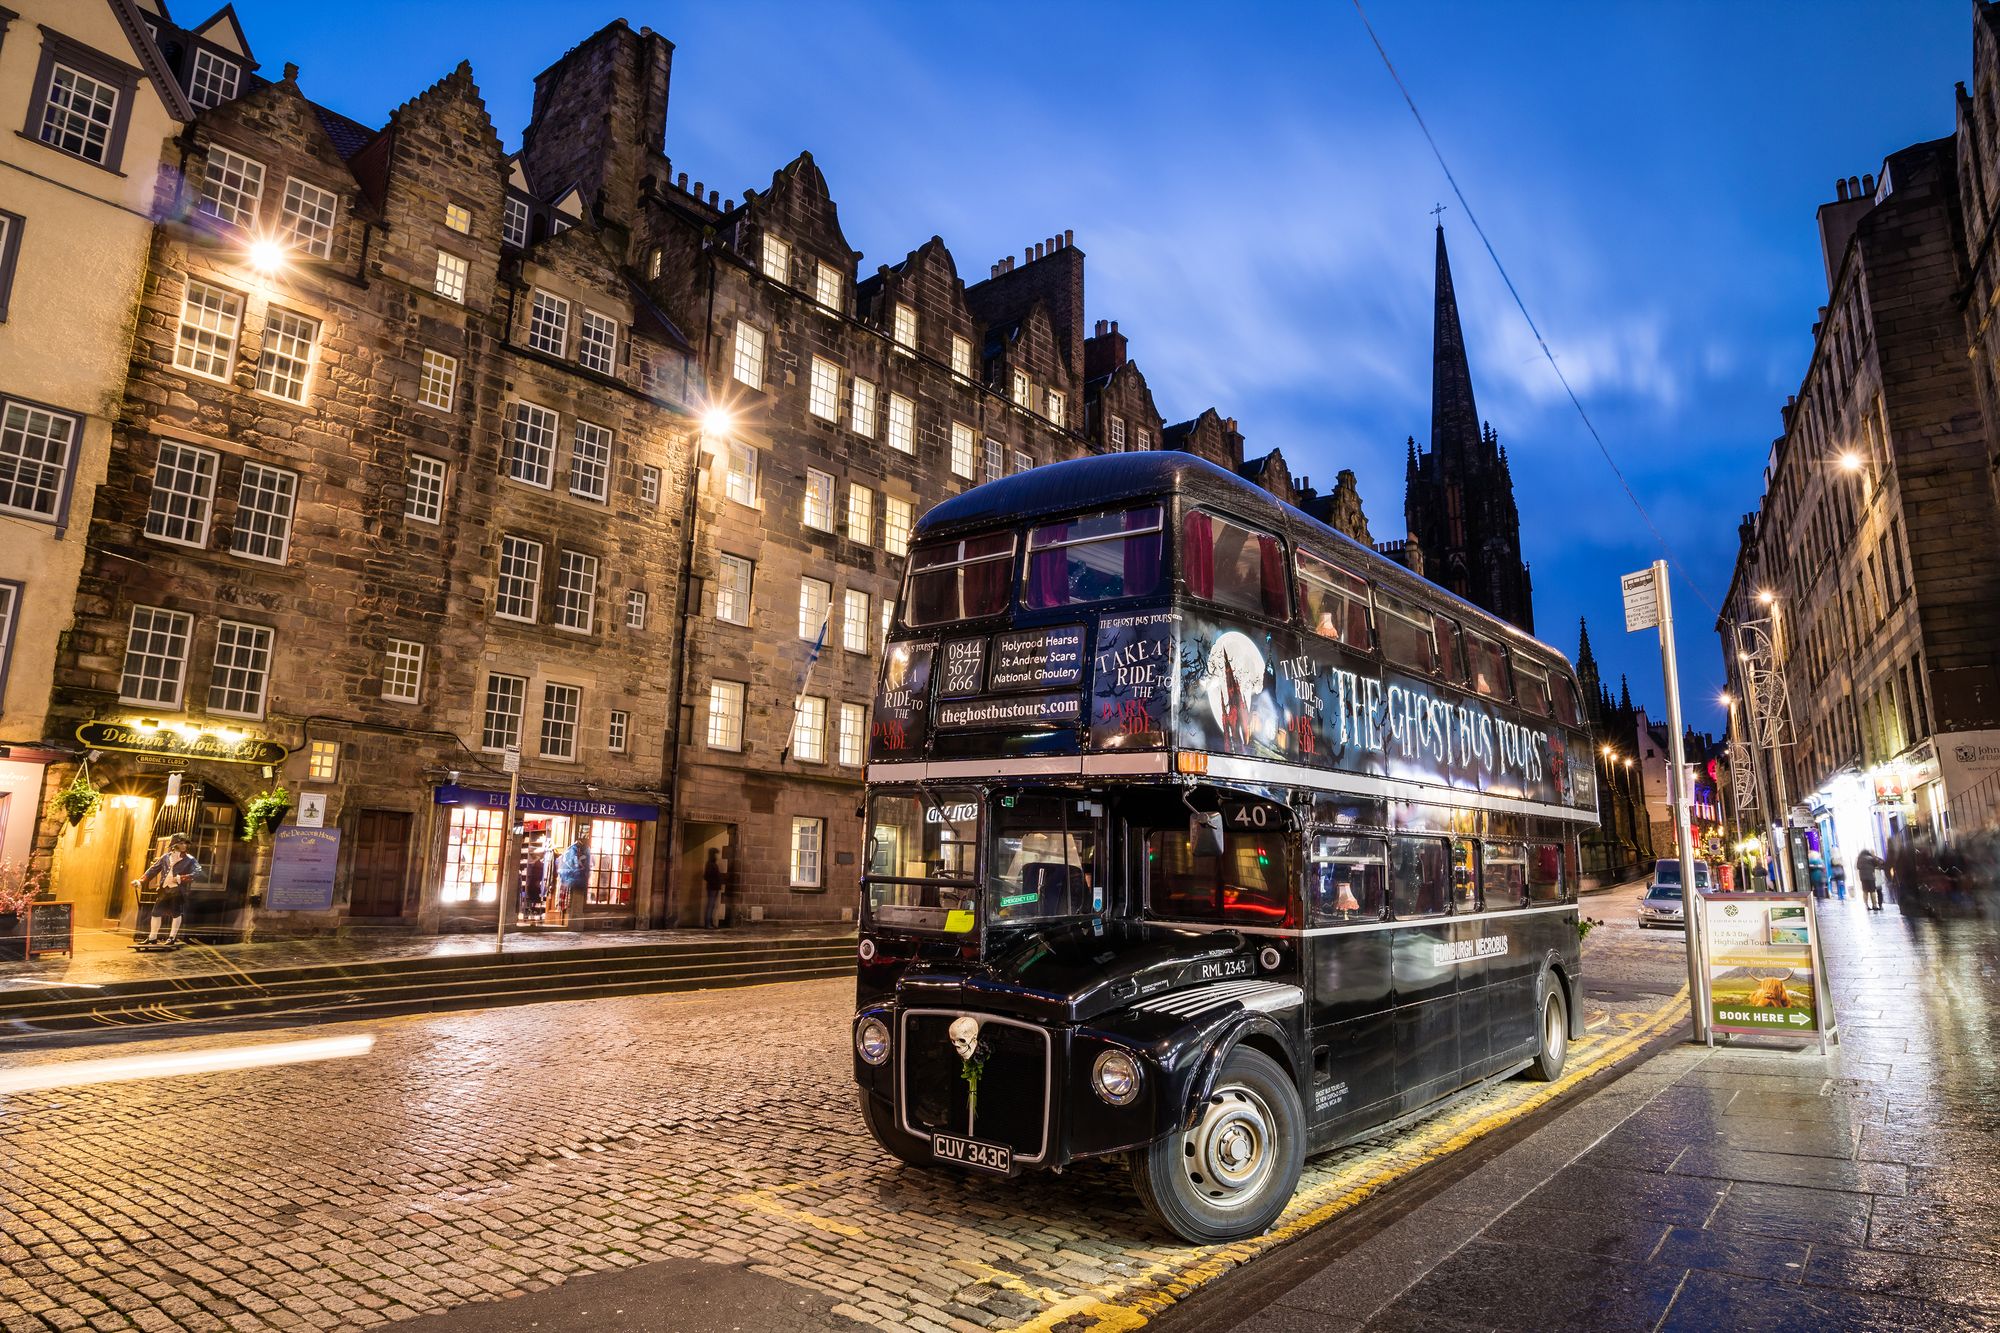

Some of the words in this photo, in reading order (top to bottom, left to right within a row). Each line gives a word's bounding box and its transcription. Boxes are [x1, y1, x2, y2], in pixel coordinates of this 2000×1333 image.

[1100, 620, 1112, 629] THE
[1113, 617, 1134, 627] GHOST
[1135, 616, 1149, 626] BUS
[949, 642, 982, 660] 0844
[1002, 638, 1042, 652] Holyrood
[1046, 636, 1079, 647] Hearse
[1002, 658, 1010, 668] St
[1012, 655, 1048, 666] Andrew
[1050, 652, 1076, 662] Scare
[1096, 640, 1149, 674] TAKE
[1151, 640, 1162, 656] A
[910, 669, 918, 682] A
[948, 659, 980, 676] 5677
[994, 672, 1032, 684] National
[1034, 668, 1080, 680] Ghoulery
[1117, 664, 1156, 686] RIDE
[1156, 675, 1173, 688] TO
[1280, 656, 1311, 680] TAKE
[1310, 660, 1317, 676] A
[948, 675, 974, 692] 666
[1132, 686, 1153, 698] THE
[884, 690, 912, 708] RIDE
[911, 700, 924, 710] TO
[1294, 678, 1315, 702] RIDE
[1314, 696, 1324, 710] TO
[894, 708, 910, 719] THE
[941, 700, 1078, 725] theghostbustours.com
[1103, 698, 1148, 720] DARK
[1304, 702, 1315, 718] THE
[873, 720, 905, 736] DARK
[1288, 714, 1313, 736] DARK
[1332, 667, 1384, 751] THE
[1388, 686, 1454, 766] GHOST
[1459, 707, 1494, 775] BUS
[1496, 719, 1543, 782] TOURS
[102, 728, 178, 748] Deacon's
[183, 735, 230, 753] House
[542, 799, 616, 816] CASHMERE
[1234, 806, 1266, 827] 40
[1434, 940, 1474, 966] EDINBURGH
[1476, 935, 1508, 955] NECROBUS
[1714, 939, 1749, 947] Highland
[1202, 964, 1224, 978] RML
[1224, 960, 1246, 976] 2343
[1720, 1010, 1750, 1020] BOOK
[1754, 1012, 1784, 1022] HERE
[936, 1138, 965, 1158] CUV
[968, 1144, 1007, 1169] 343C
